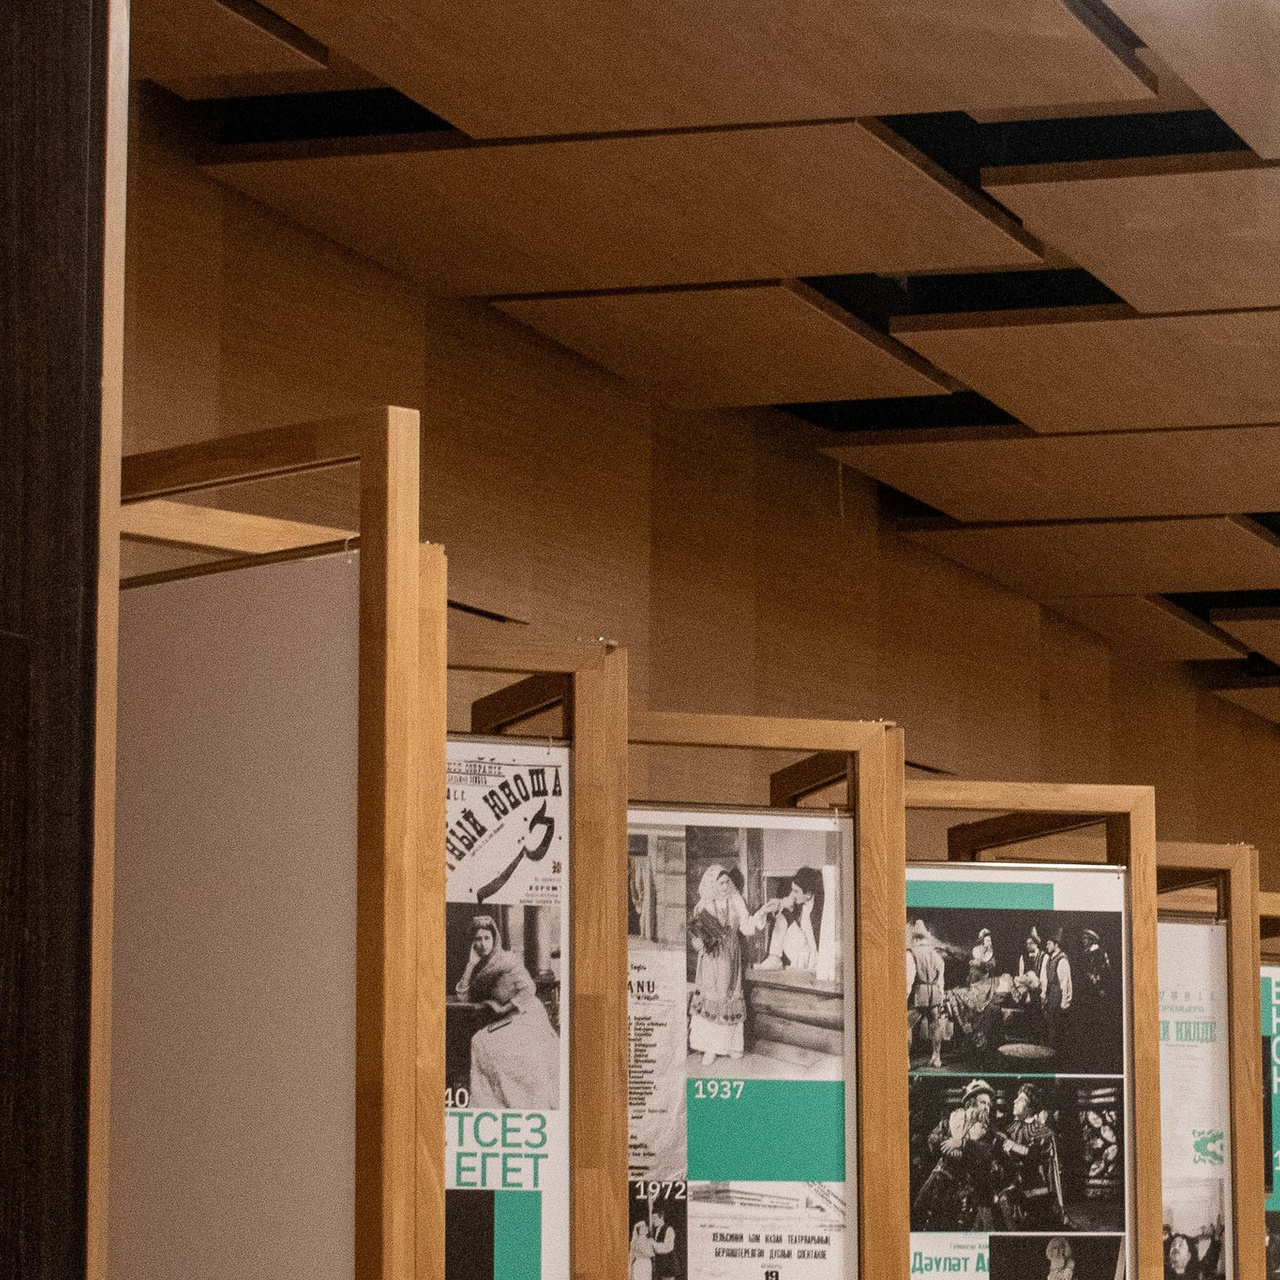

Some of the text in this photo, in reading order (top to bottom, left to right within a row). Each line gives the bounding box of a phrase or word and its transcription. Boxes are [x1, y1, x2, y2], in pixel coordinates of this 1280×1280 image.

[483, 767, 562, 821] ЮНОША
[693, 1080, 745, 1099] 1937
[445, 1111, 548, 1149] ТСЕЗ
[456, 1152, 549, 1188] ЕГЕТ
[635, 1181, 687, 1200] 1972
